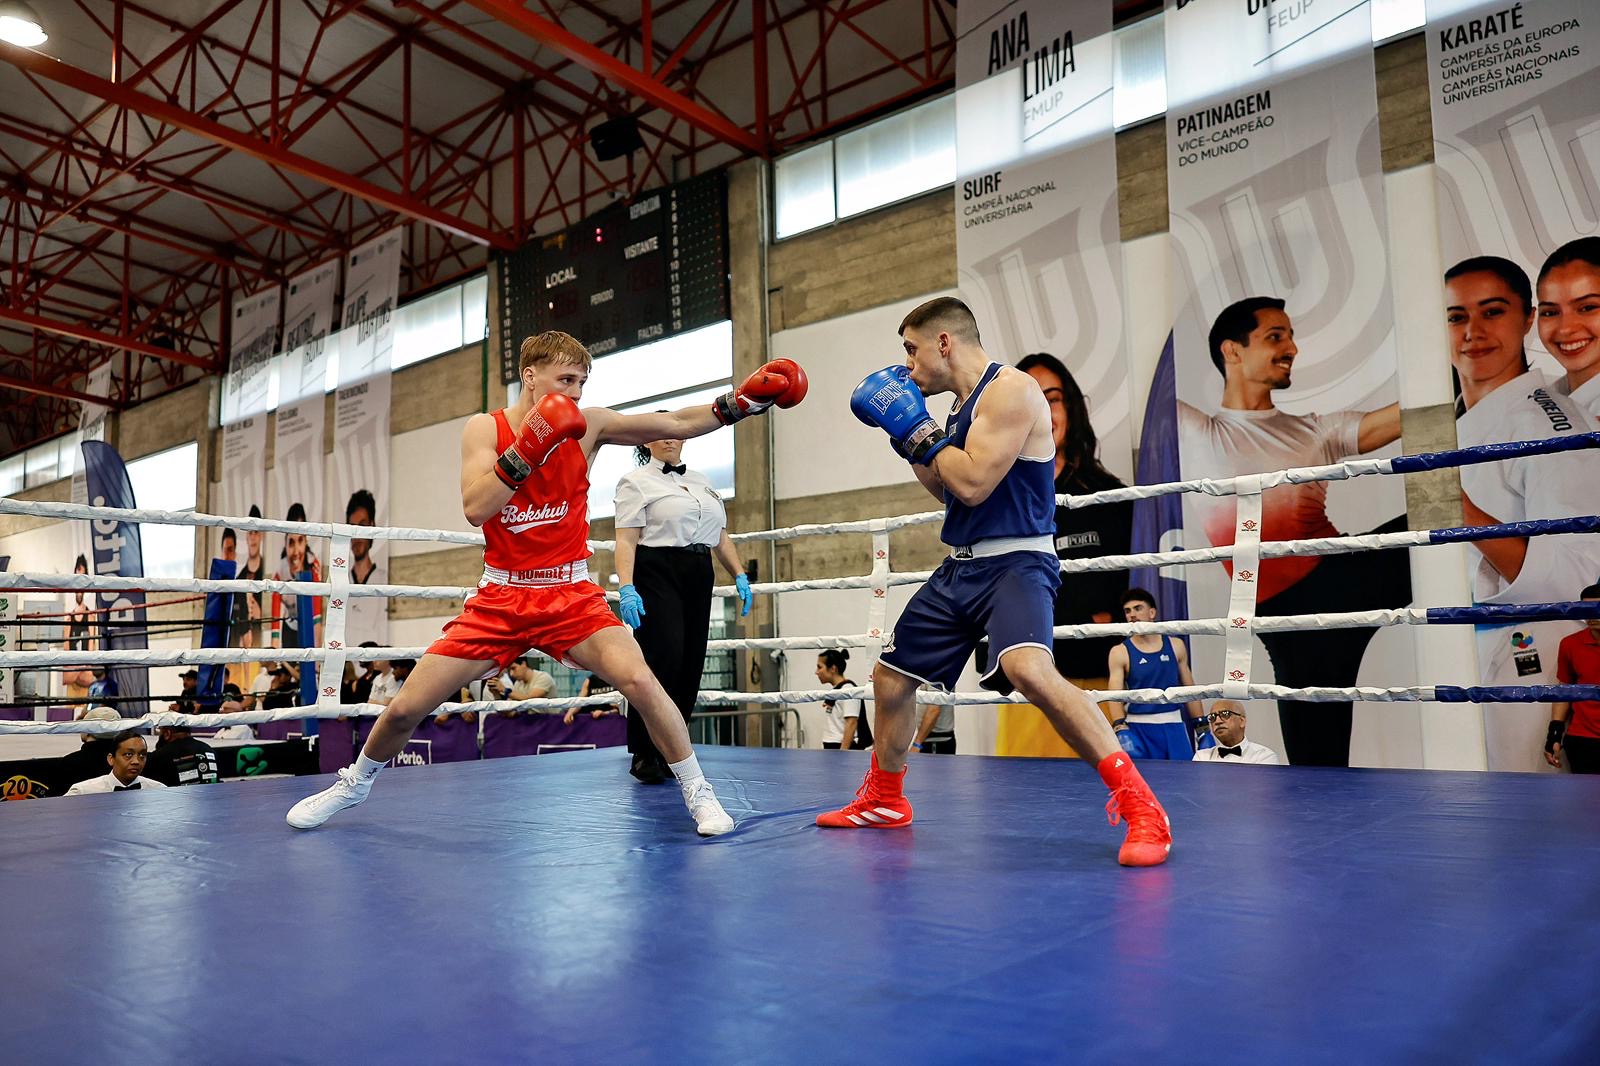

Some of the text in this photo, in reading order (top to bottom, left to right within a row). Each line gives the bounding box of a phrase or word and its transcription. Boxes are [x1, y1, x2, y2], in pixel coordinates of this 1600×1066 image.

[1268, 0, 1313, 34] FEUP
[1440, 2, 1524, 51] KARATÉ
[988, 11, 1030, 76] ANA
[1440, 18, 1580, 69] CAMPEÃS DA EUROPA
[1023, 30, 1075, 102] LIMA
[1442, 42, 1542, 80] UNIVERSITÁRIAS
[1442, 45, 1580, 94] CAMPEÃS NACIONAIS
[1443, 68, 1543, 105] UNIVERSITÁRIAS
[1023, 91, 1064, 125] FMUP
[1178, 90, 1271, 137] PATINAGEM
[1178, 115, 1275, 153] VICE-CAMPEÃO
[1179, 138, 1249, 167] DO MUNDO
[964, 171, 1002, 201] SURF
[1006, 181, 1057, 204] NACIONAL
[624, 236, 659, 260] VISITANTE
[546, 267, 577, 288] LOCAL
[670, 260, 680, 271] 10
[671, 272, 679, 283] 11
[671, 284, 680, 294] 12
[638, 323, 664, 340] FALTAS
[869, 378, 911, 415] LEONE
[397, 750, 426, 765] Porto.
[6, 778, 29, 796] 20
